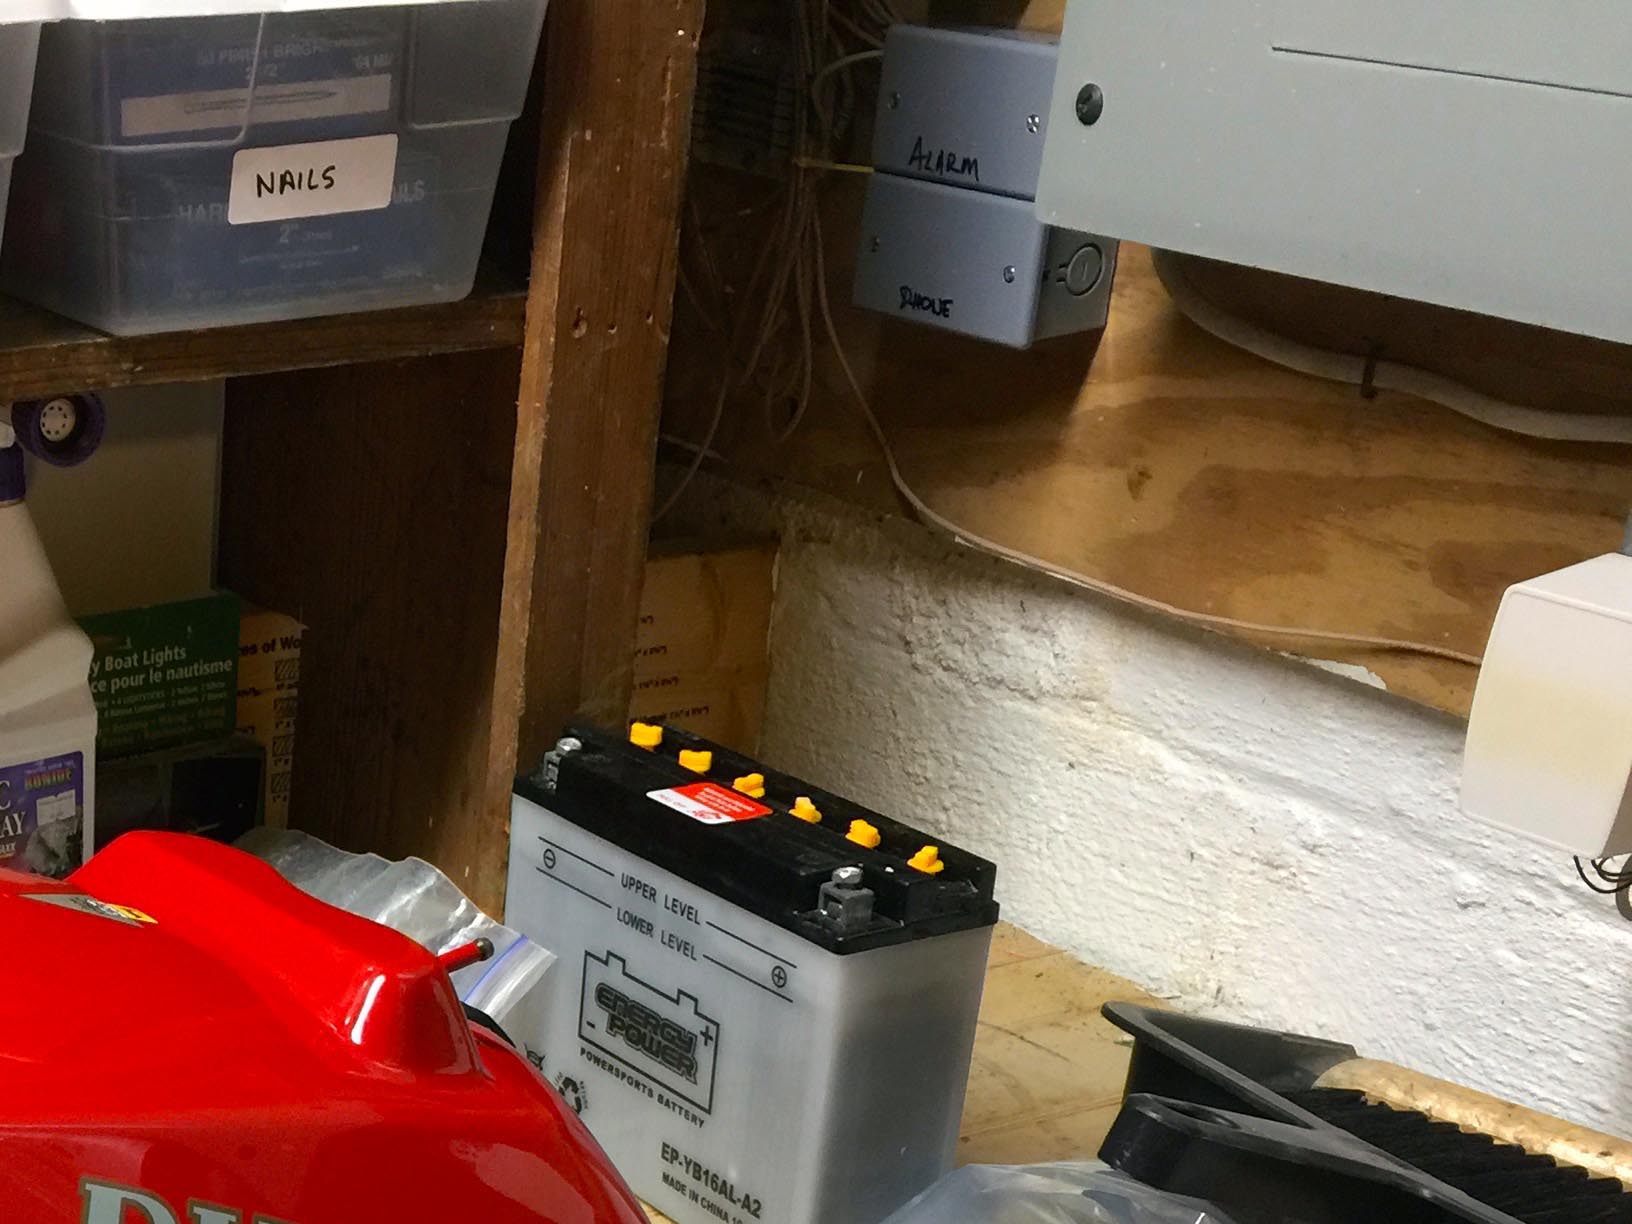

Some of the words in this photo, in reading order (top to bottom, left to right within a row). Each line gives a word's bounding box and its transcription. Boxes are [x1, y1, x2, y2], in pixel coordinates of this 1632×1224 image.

[256, 164, 336, 198] NAILS
[909, 136, 980, 181] ALARM
[105, 654, 138, 672] Boat
[143, 646, 187, 669] Lights
[111, 673, 146, 694] pour
[150, 667, 161, 683] le
[166, 658, 233, 681] nautisme
[621, 872, 657, 903] UPPER
[664, 894, 701, 926] LEVEL
[617, 907, 654, 938] LOWER
[660, 929, 697, 961] LEVEL
[595, 982, 698, 1055] ENERGY
[606, 1013, 698, 1085] POWER
[580, 1047, 654, 1098] POWERSPORTS
[657, 1093, 705, 1128] BATTERY
[661, 1142, 762, 1220] EP-YB16AL-A2
[662, 1172, 687, 1197] MADE
[689, 1189, 699, 1204] IN
[700, 1197, 729, 1224] CHINA
